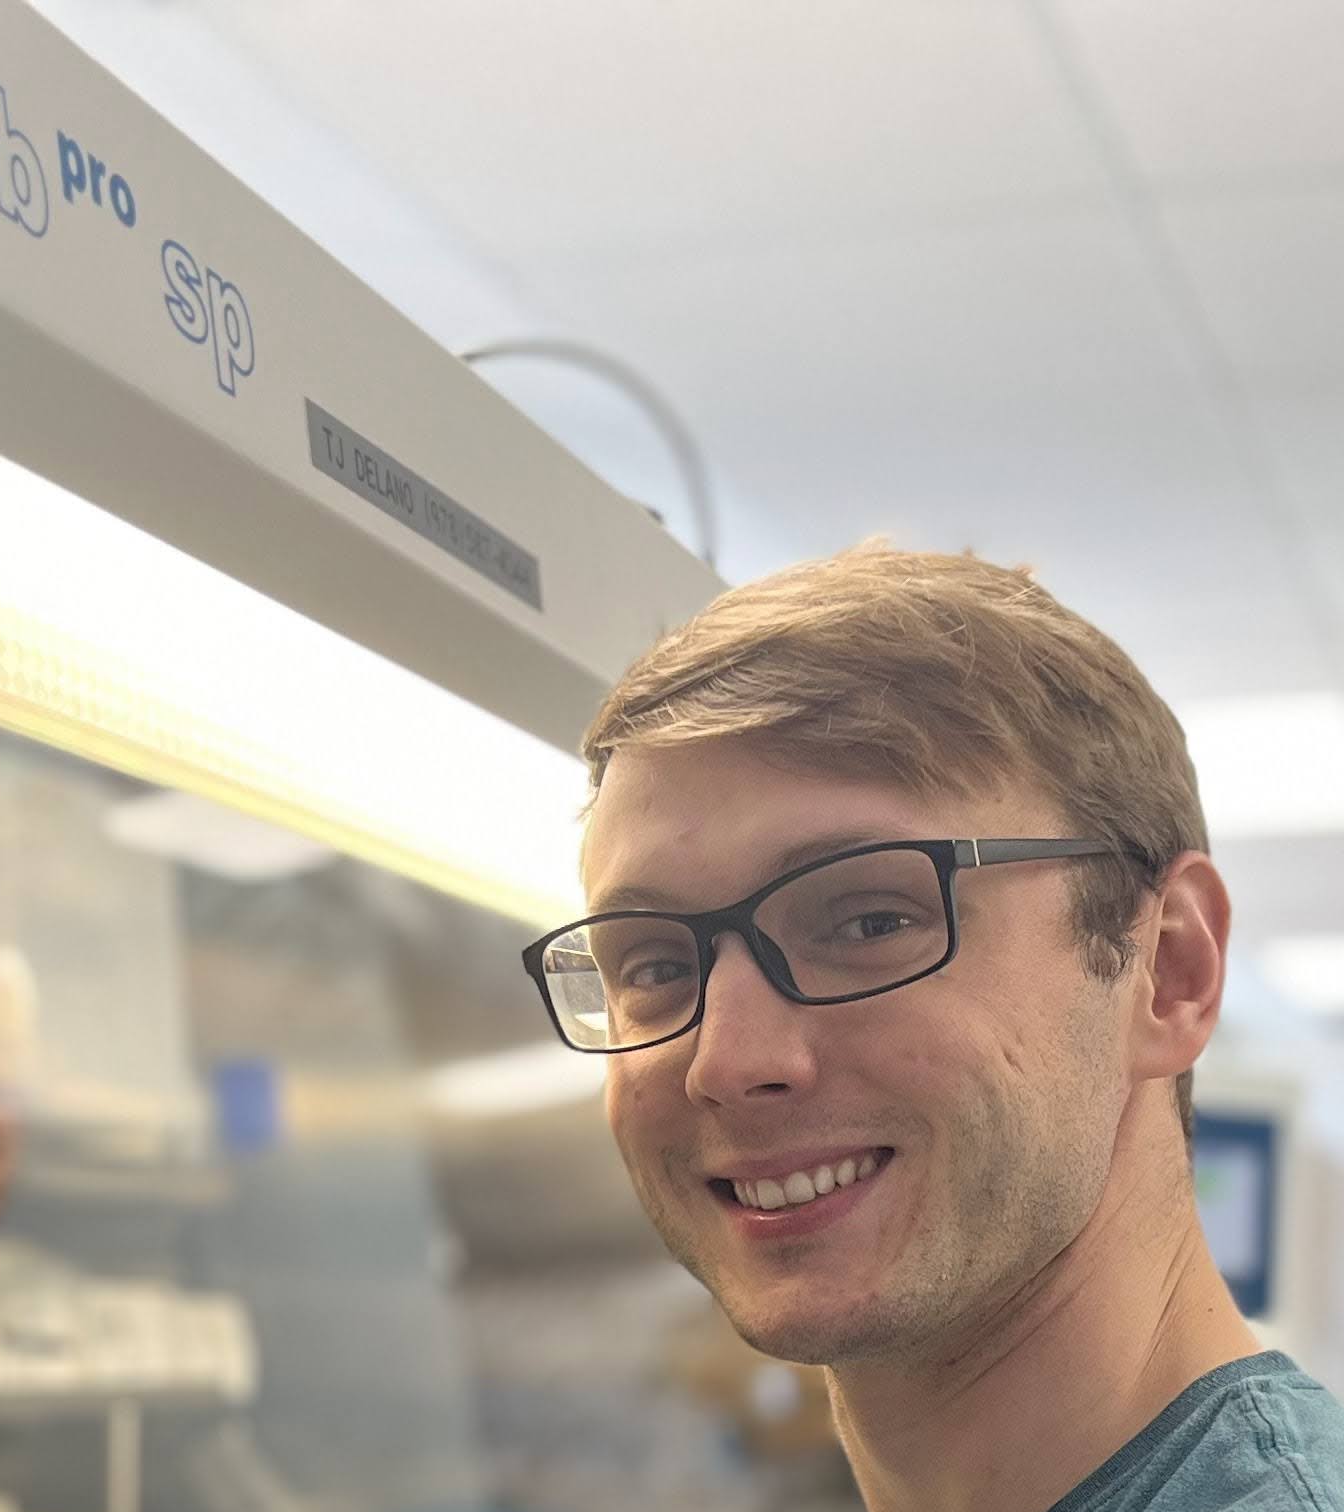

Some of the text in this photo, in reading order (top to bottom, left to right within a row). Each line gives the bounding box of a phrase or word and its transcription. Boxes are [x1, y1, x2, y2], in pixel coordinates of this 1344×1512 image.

[57, 130, 137, 228] pro
[161, 239, 255, 397] sp
[321, 426, 345, 470] TJ
[353, 448, 414, 515] DELANO
